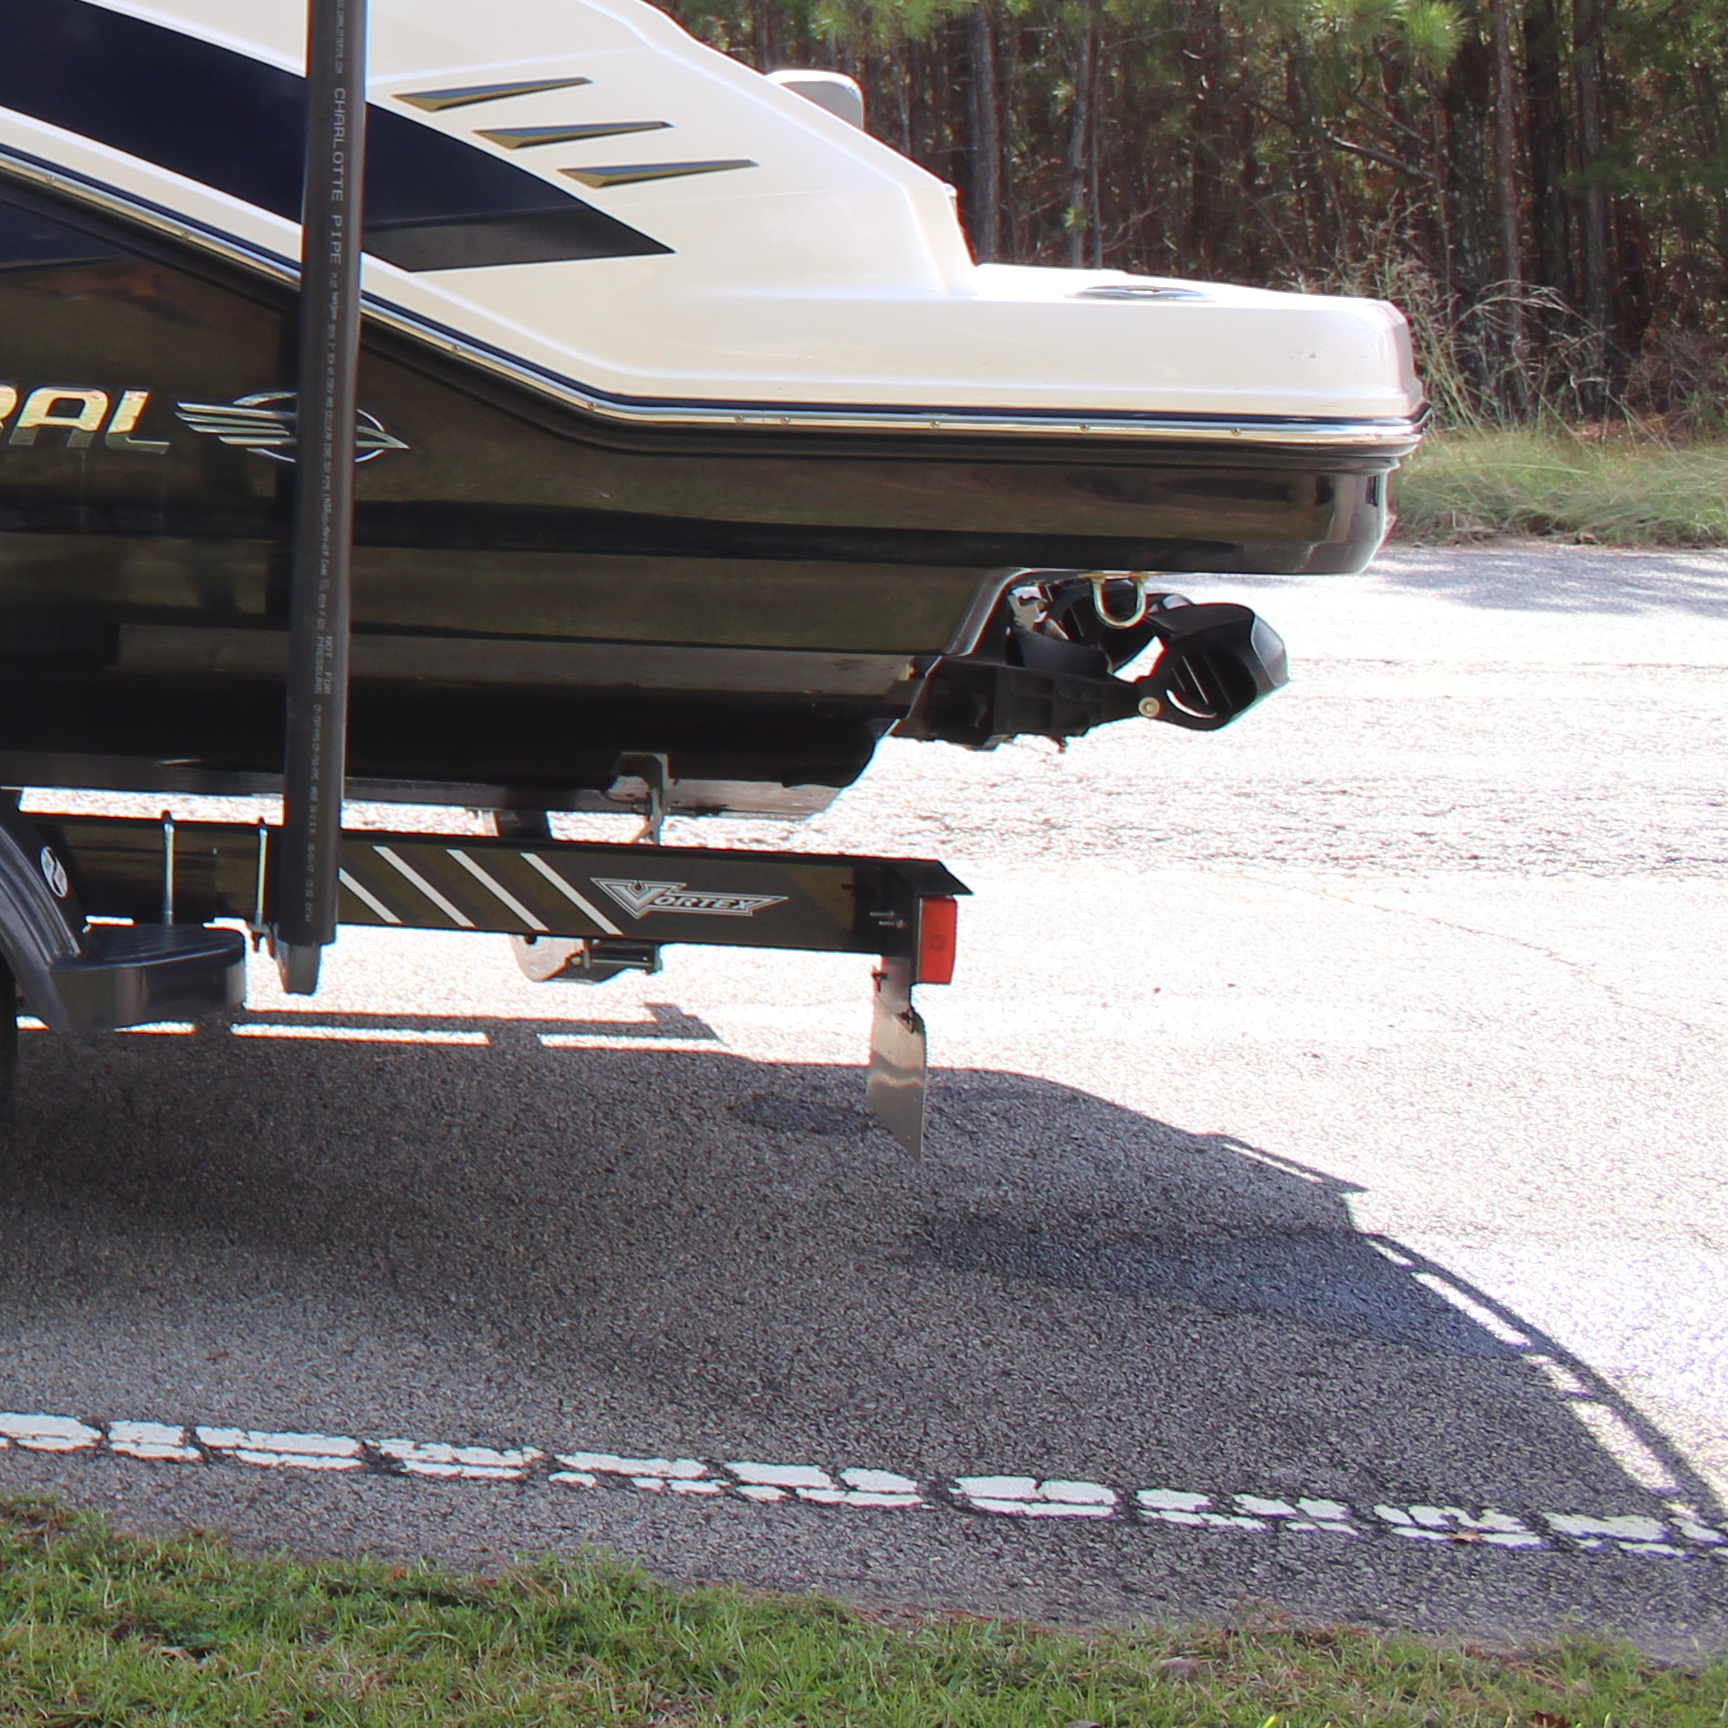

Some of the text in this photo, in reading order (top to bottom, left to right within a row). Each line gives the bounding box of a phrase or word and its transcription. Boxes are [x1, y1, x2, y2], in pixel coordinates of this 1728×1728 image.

[332, 88, 346, 201] CHARLOTTE
[330, 214, 342, 265] PIPE
[598, 878, 760, 918] VORTEX
